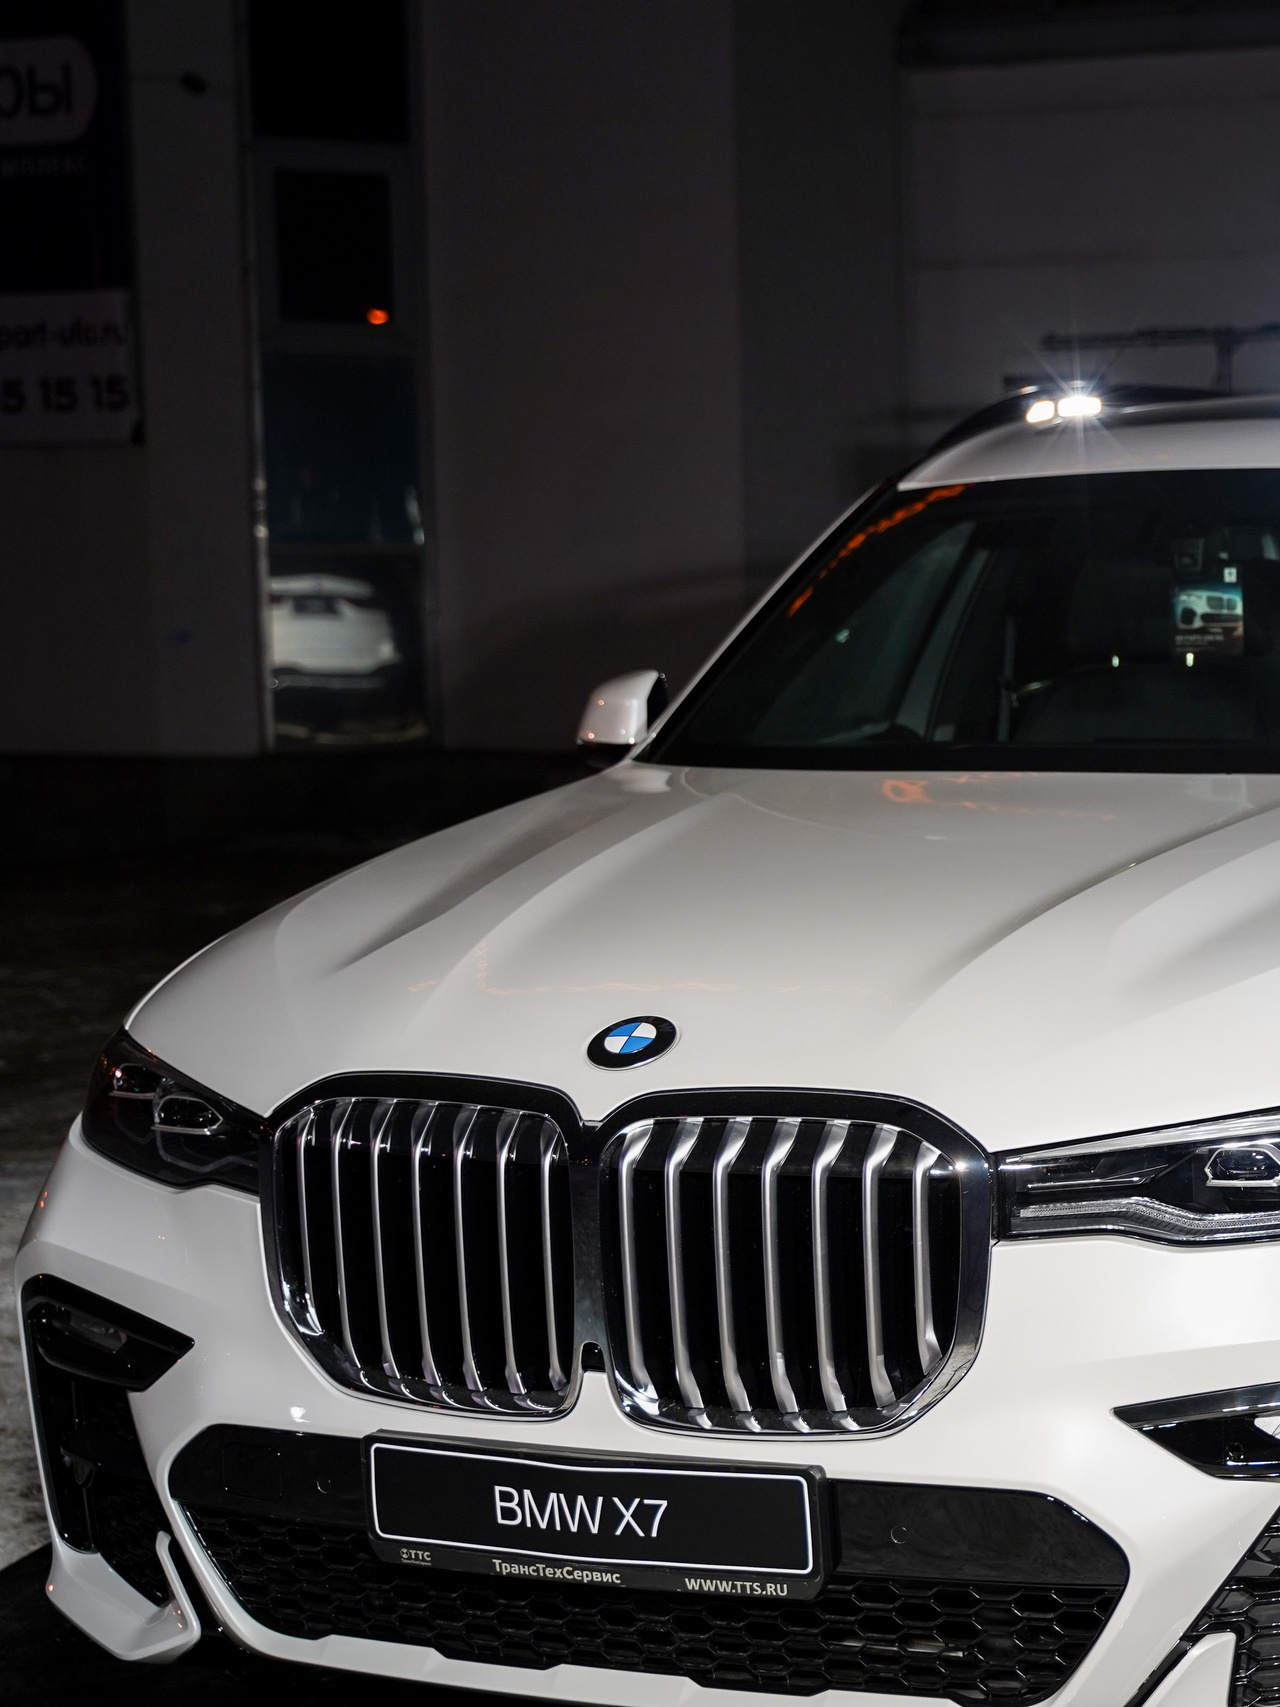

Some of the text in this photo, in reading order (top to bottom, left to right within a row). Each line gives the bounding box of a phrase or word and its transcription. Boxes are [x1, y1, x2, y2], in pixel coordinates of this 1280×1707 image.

[39, 373, 78, 414] 15
[88, 371, 129, 411] 15
[494, 1485, 668, 1537] BMW X7
[492, 1559, 621, 1584] ТрансТехСервис
[685, 1578, 788, 1596] WWW.TTS.RU
